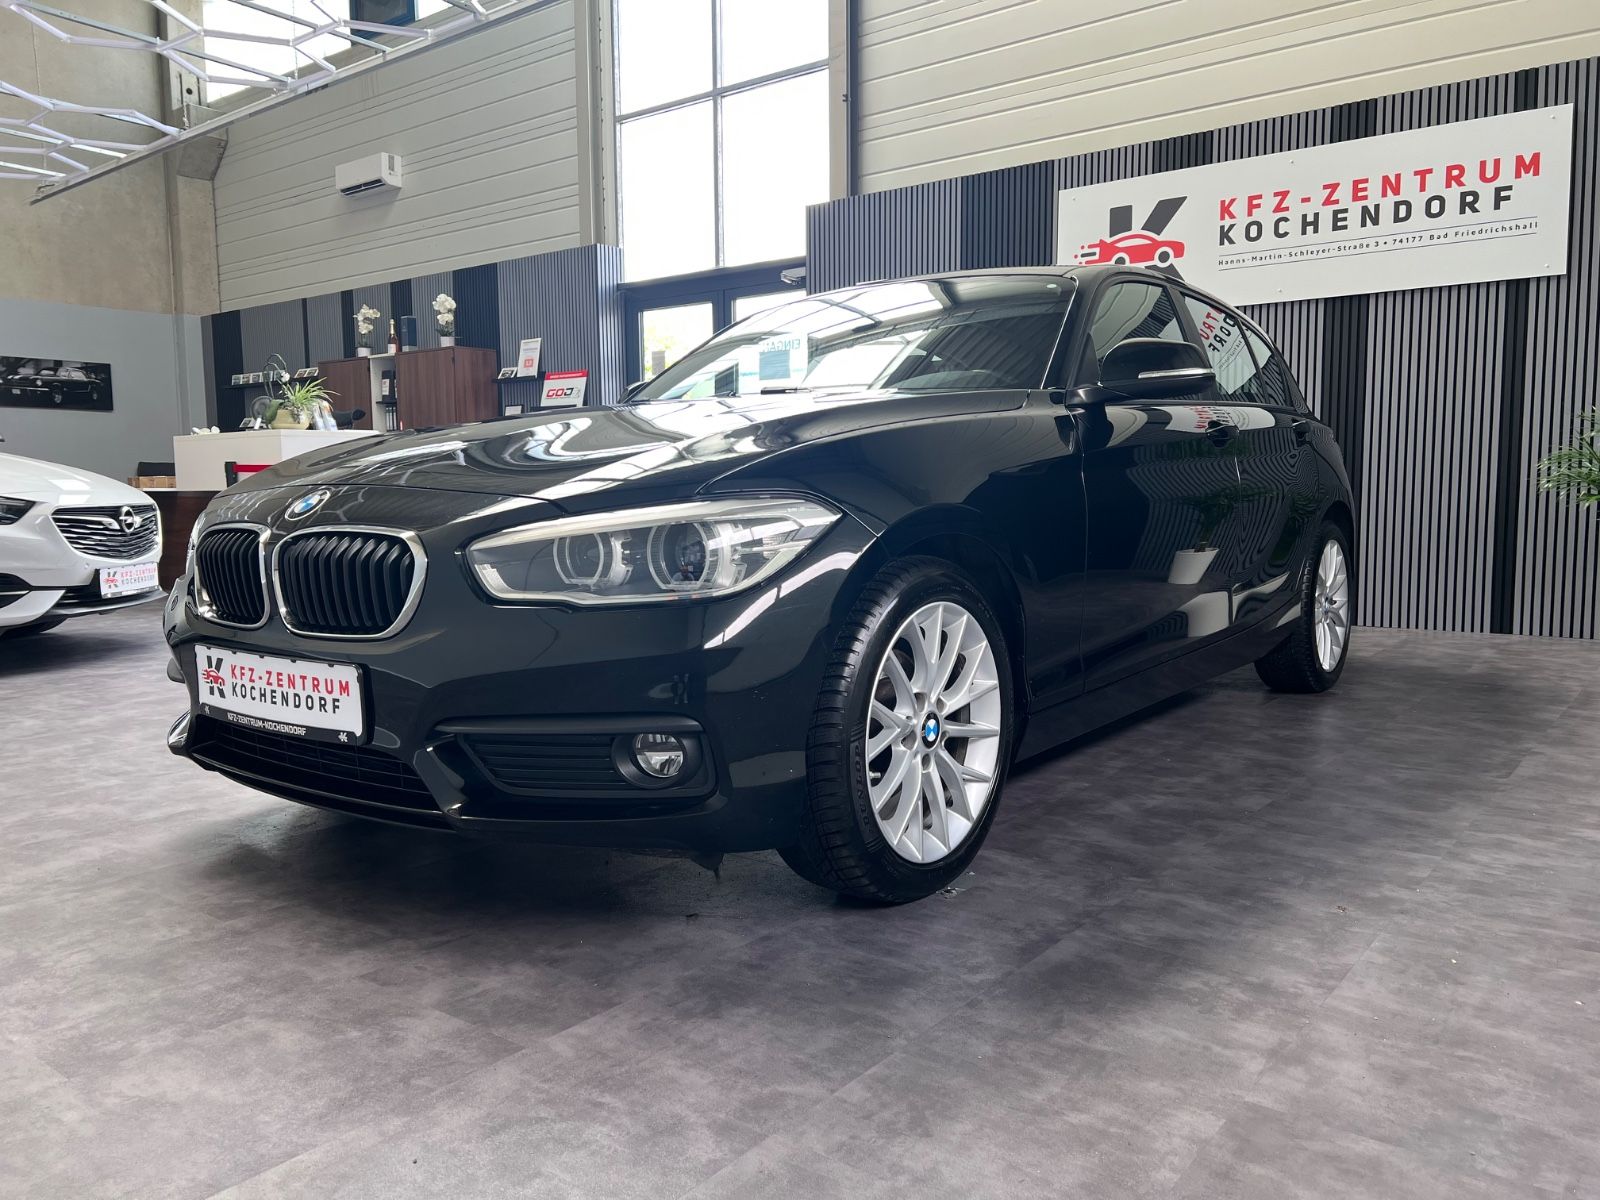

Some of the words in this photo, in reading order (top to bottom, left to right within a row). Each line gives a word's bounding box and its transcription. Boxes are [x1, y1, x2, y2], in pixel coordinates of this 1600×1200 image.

[1219, 152, 1541, 221] KFZ-ZENTRUM
[1218, 185, 1513, 246] KOCHENDORF
[1218, 241, 1370, 266] Hanns-Martin-Schleyer-Straße
[1392, 235, 1424, 245] 74177
[1429, 232, 1448, 241] Bad
[1454, 221, 1538, 238] Friedrichshall
[230, 663, 350, 697] KFZ-ZENTRUM
[231, 682, 340, 714] KOCHENDORF
[227, 712, 307, 736] KFZ-ZENTRUM-KOCHENDORF
